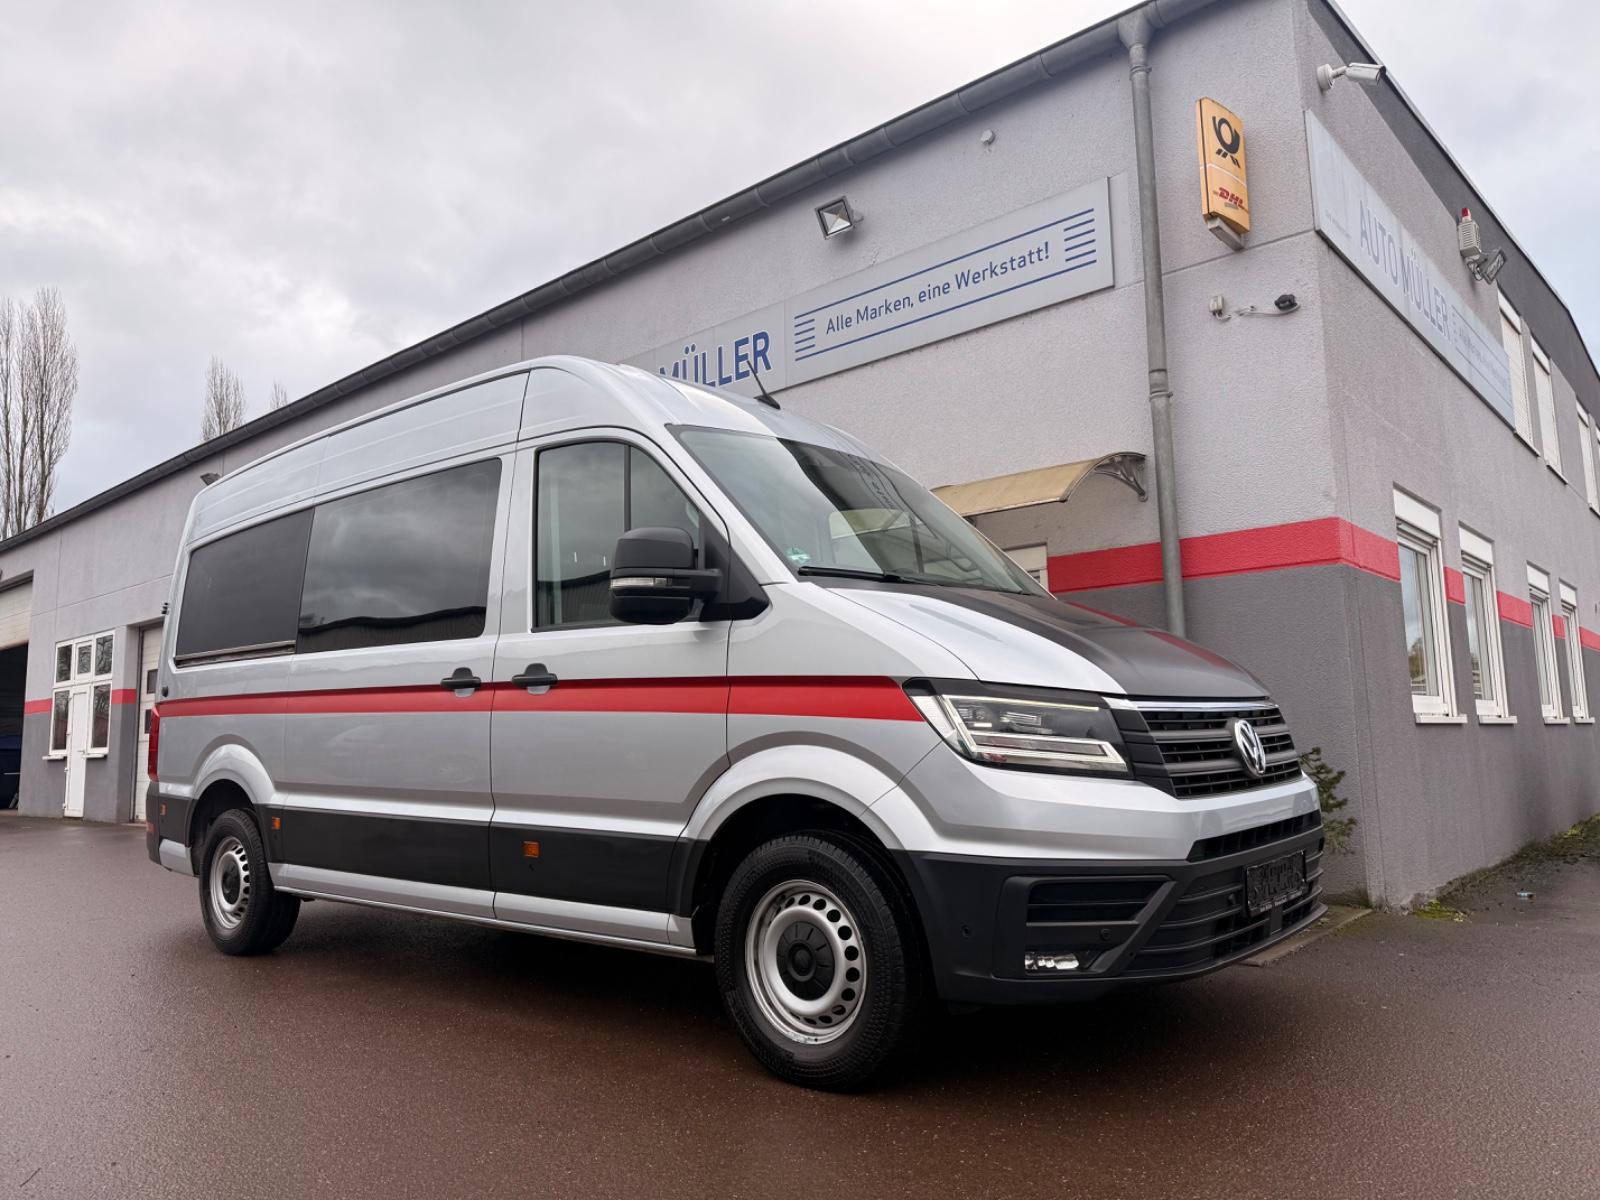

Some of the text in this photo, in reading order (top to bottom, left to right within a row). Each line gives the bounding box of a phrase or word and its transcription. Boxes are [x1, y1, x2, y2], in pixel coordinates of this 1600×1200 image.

[1218, 186, 1245, 209] DHL
[826, 241, 1050, 335] Alle Marken, eine Werkstatt!
[1360, 199, 1451, 341] AUTO MÜLLER
